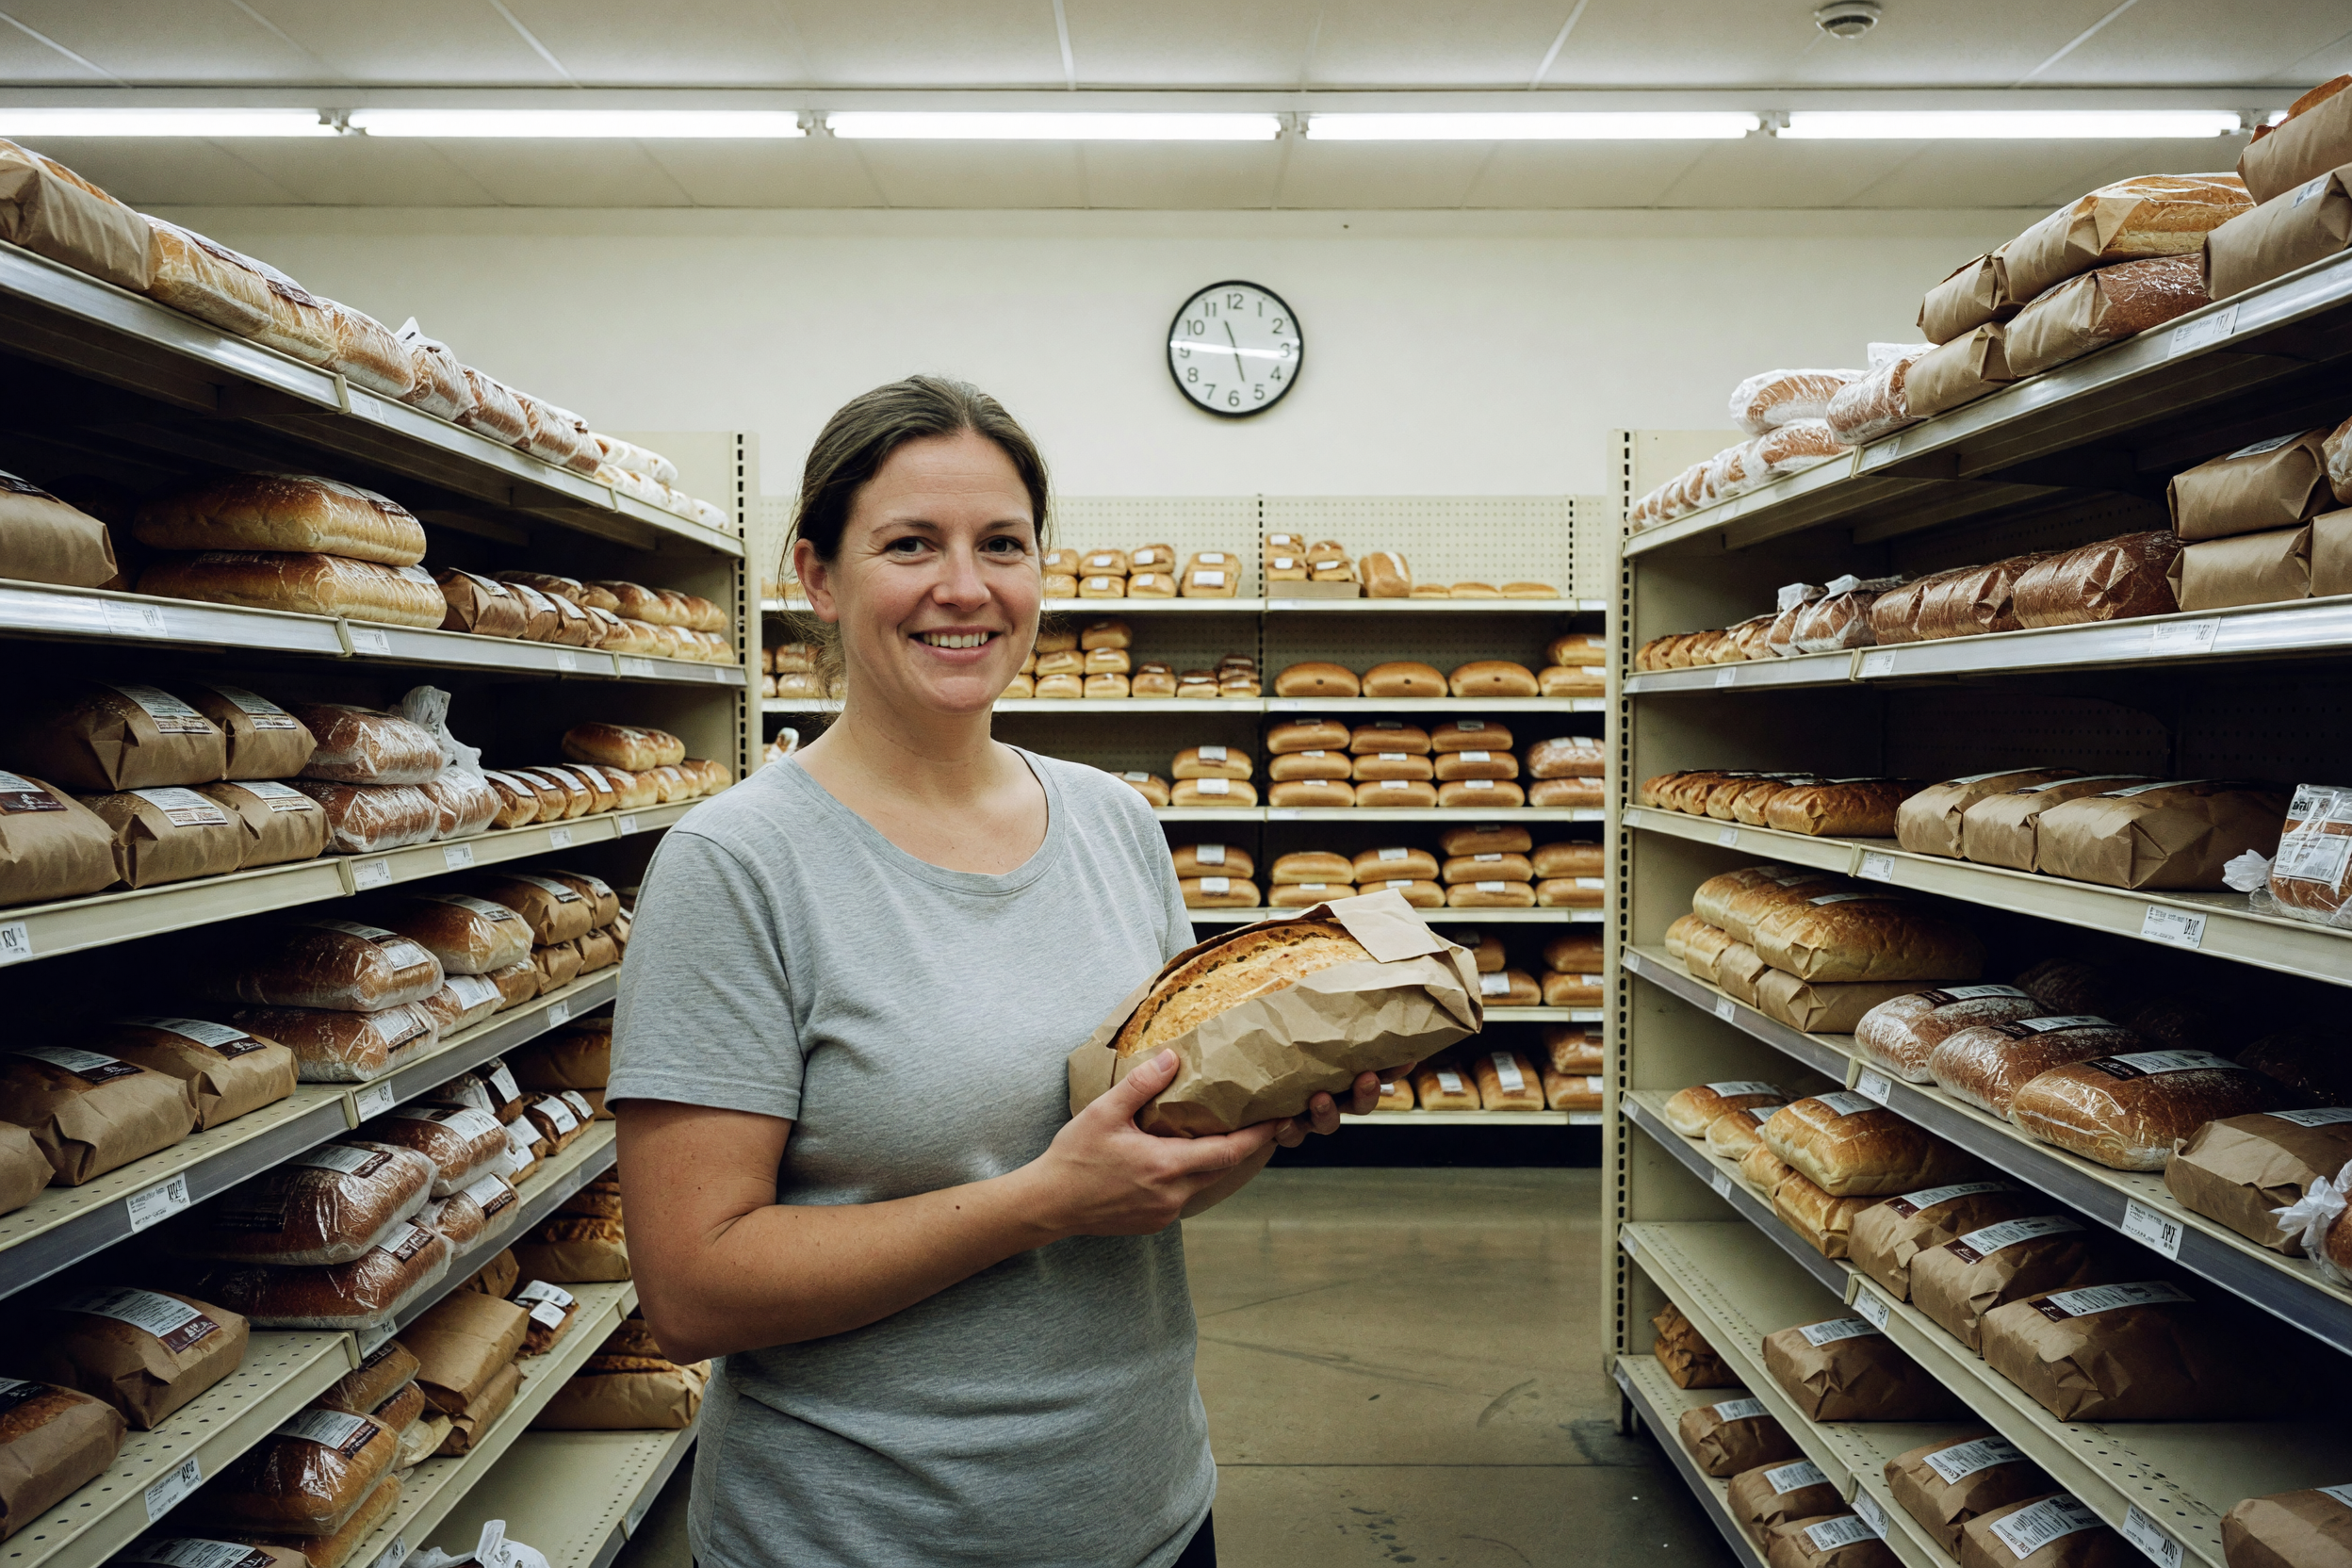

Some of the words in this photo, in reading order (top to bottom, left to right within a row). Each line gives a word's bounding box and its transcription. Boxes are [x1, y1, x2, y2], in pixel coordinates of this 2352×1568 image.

[1227, 293, 1244, 310] 12
[1257, 301, 1263, 318] 1
[1204, 302, 1217, 318] 11
[1186, 319, 1205, 335] 10
[1272, 318, 1284, 335] 2
[1280, 342, 1291, 358] 3
[1186, 367, 1199, 384] 8
[1270, 366, 1282, 382] 4
[1203, 384, 1217, 400] 7
[1228, 390, 1240, 407] 6
[1253, 384, 1266, 400] 5
